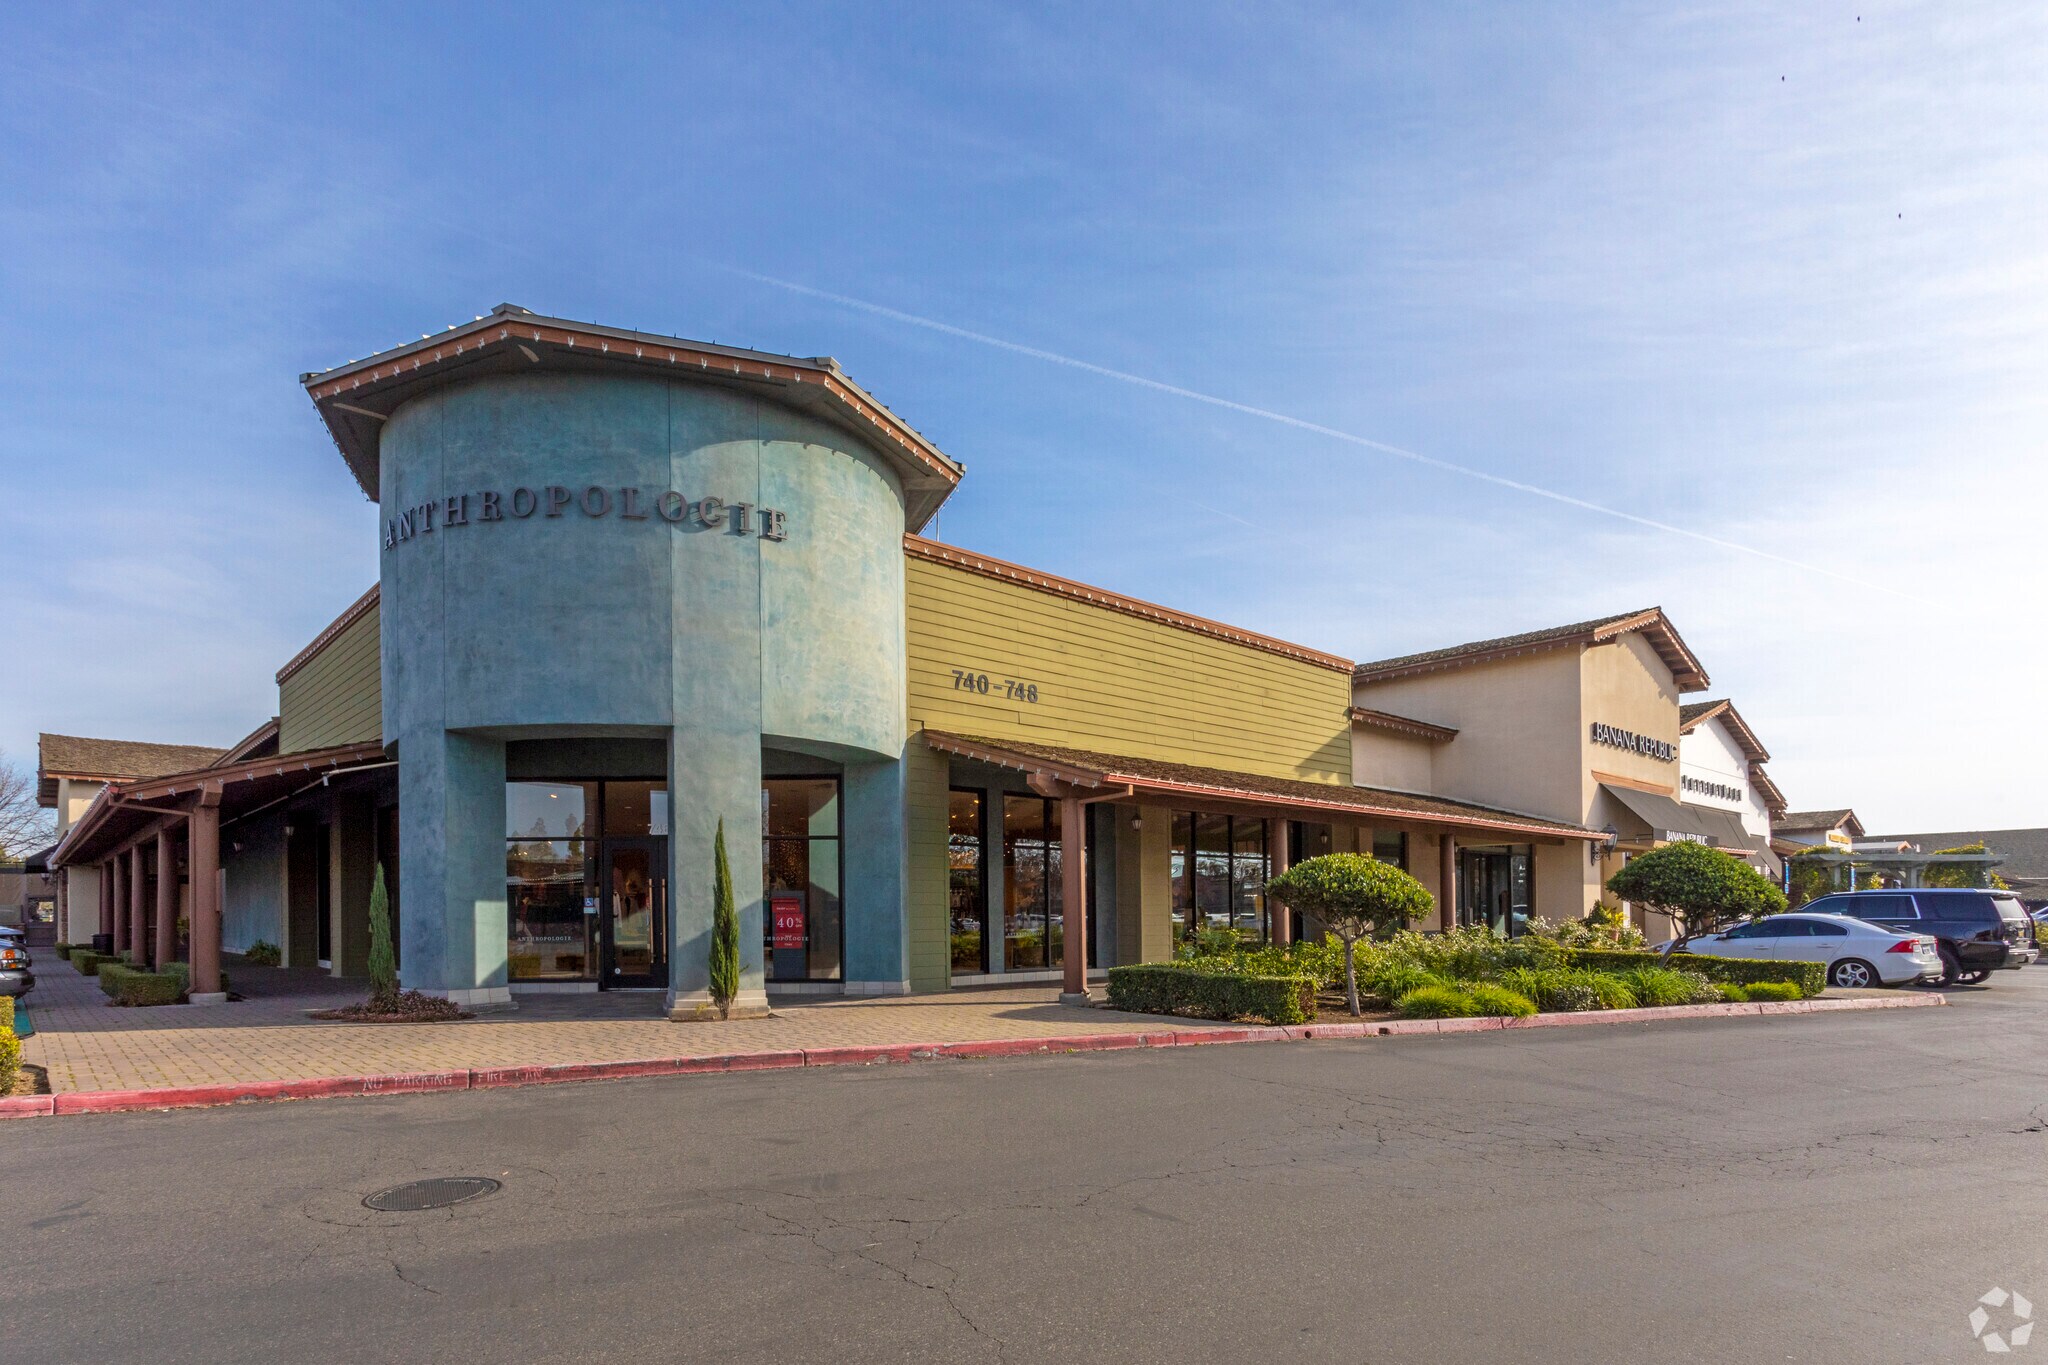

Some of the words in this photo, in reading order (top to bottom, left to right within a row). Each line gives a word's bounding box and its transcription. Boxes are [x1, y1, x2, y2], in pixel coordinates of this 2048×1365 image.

[384, 485, 788, 551] ANTHROPOLOGIE
[1594, 722, 1637, 752] BANANA
[1639, 735, 1677, 761] REPUBLIC
[1666, 830, 1686, 843] BANANA
[363, 1076, 383, 1091] NO
[393, 1074, 453, 1090] PARKING
